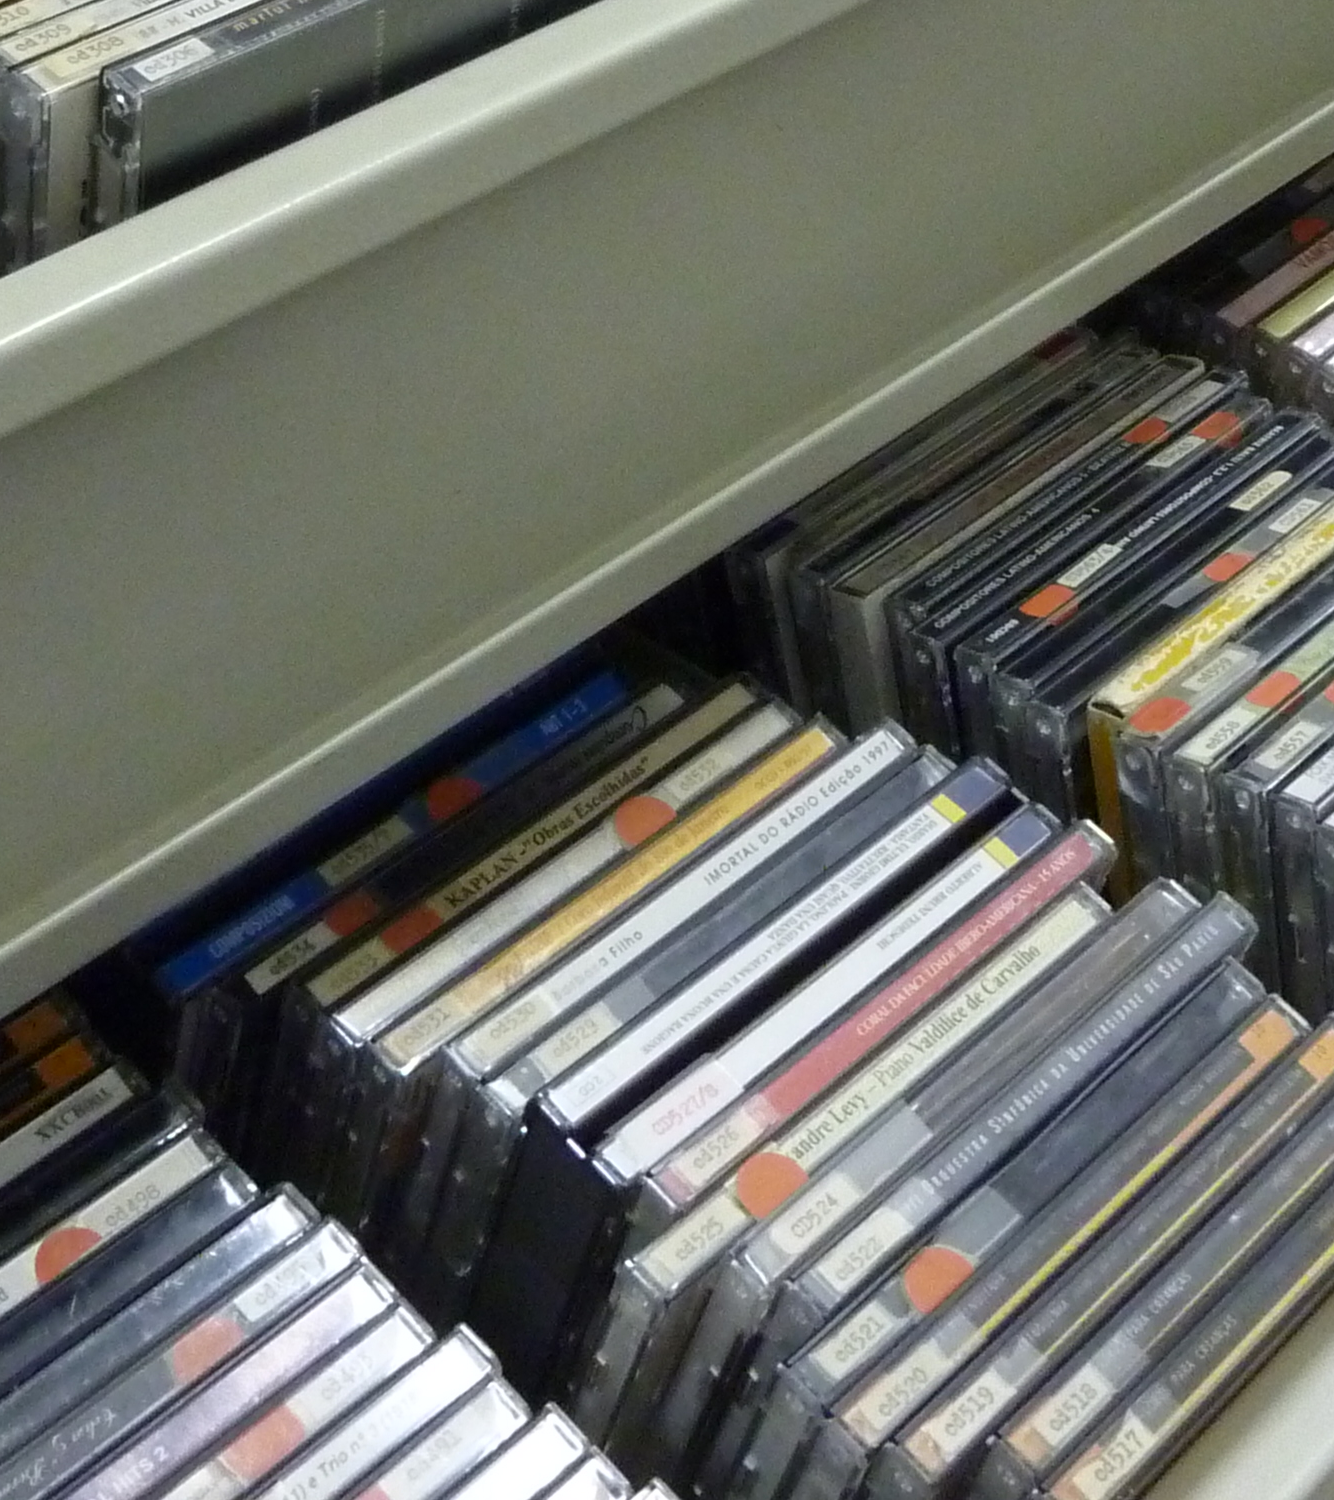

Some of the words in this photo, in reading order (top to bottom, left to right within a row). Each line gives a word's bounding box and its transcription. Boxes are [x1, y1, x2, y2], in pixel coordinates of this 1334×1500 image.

[442, 855, 520, 910] KAPLAN
[571, 754, 652, 820] Escolhidas"
[607, 928, 646, 961] Filho
[701, 837, 760, 890] IMORTAL
[757, 825, 781, 849] DO
[781, 794, 820, 833] RÁDIO
[818, 764, 863, 802] Edição
[862, 739, 895, 770] 1997
[916, 890, 949, 918] BRUNI
[942, 859, 986, 897] ALBERTO
[856, 1003, 893, 1038] CORAL
[1053, 847, 1080, 873] ANOS
[874, 911, 922, 951] TEDESCHI
[650, 1080, 720, 1137] CD527/8
[674, 1218, 724, 1262] cd525
[832, 1089, 866, 1129] Levy
[874, 1051, 915, 1088] Piano
[968, 989, 985, 1012] de
[982, 943, 1042, 995] Carvalho
[104, 1184, 163, 1228] cd498
[789, 1191, 841, 1239] CD524
[836, 1319, 886, 1363] cd521
[877, 1366, 931, 1420] cd520
[943, 1385, 997, 1439] cd519
[1049, 1381, 1103, 1433] cd518
[153, 1445, 169, 1464] 2
[1094, 1430, 1147, 1484] cd517
